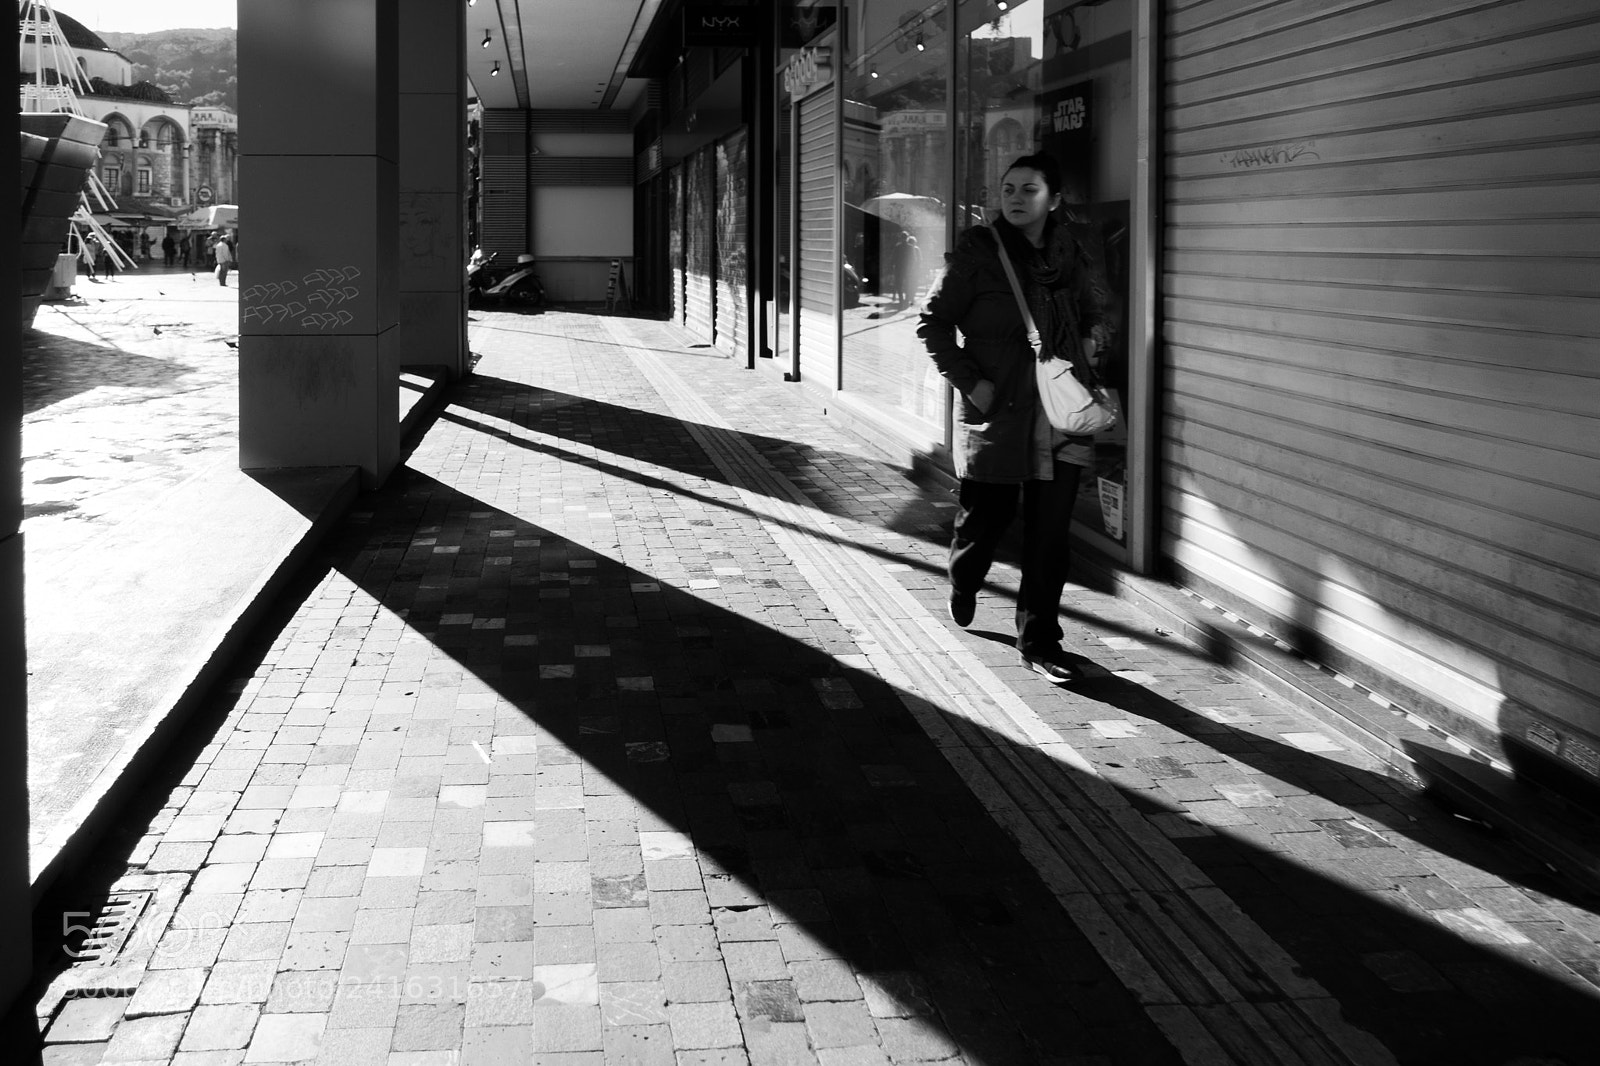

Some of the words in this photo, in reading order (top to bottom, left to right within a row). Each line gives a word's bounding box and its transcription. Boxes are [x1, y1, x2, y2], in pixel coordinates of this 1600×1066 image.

[701, 15, 741, 28] NYX
[1053, 96, 1086, 118] STAR
[1053, 112, 1086, 133] WARS
